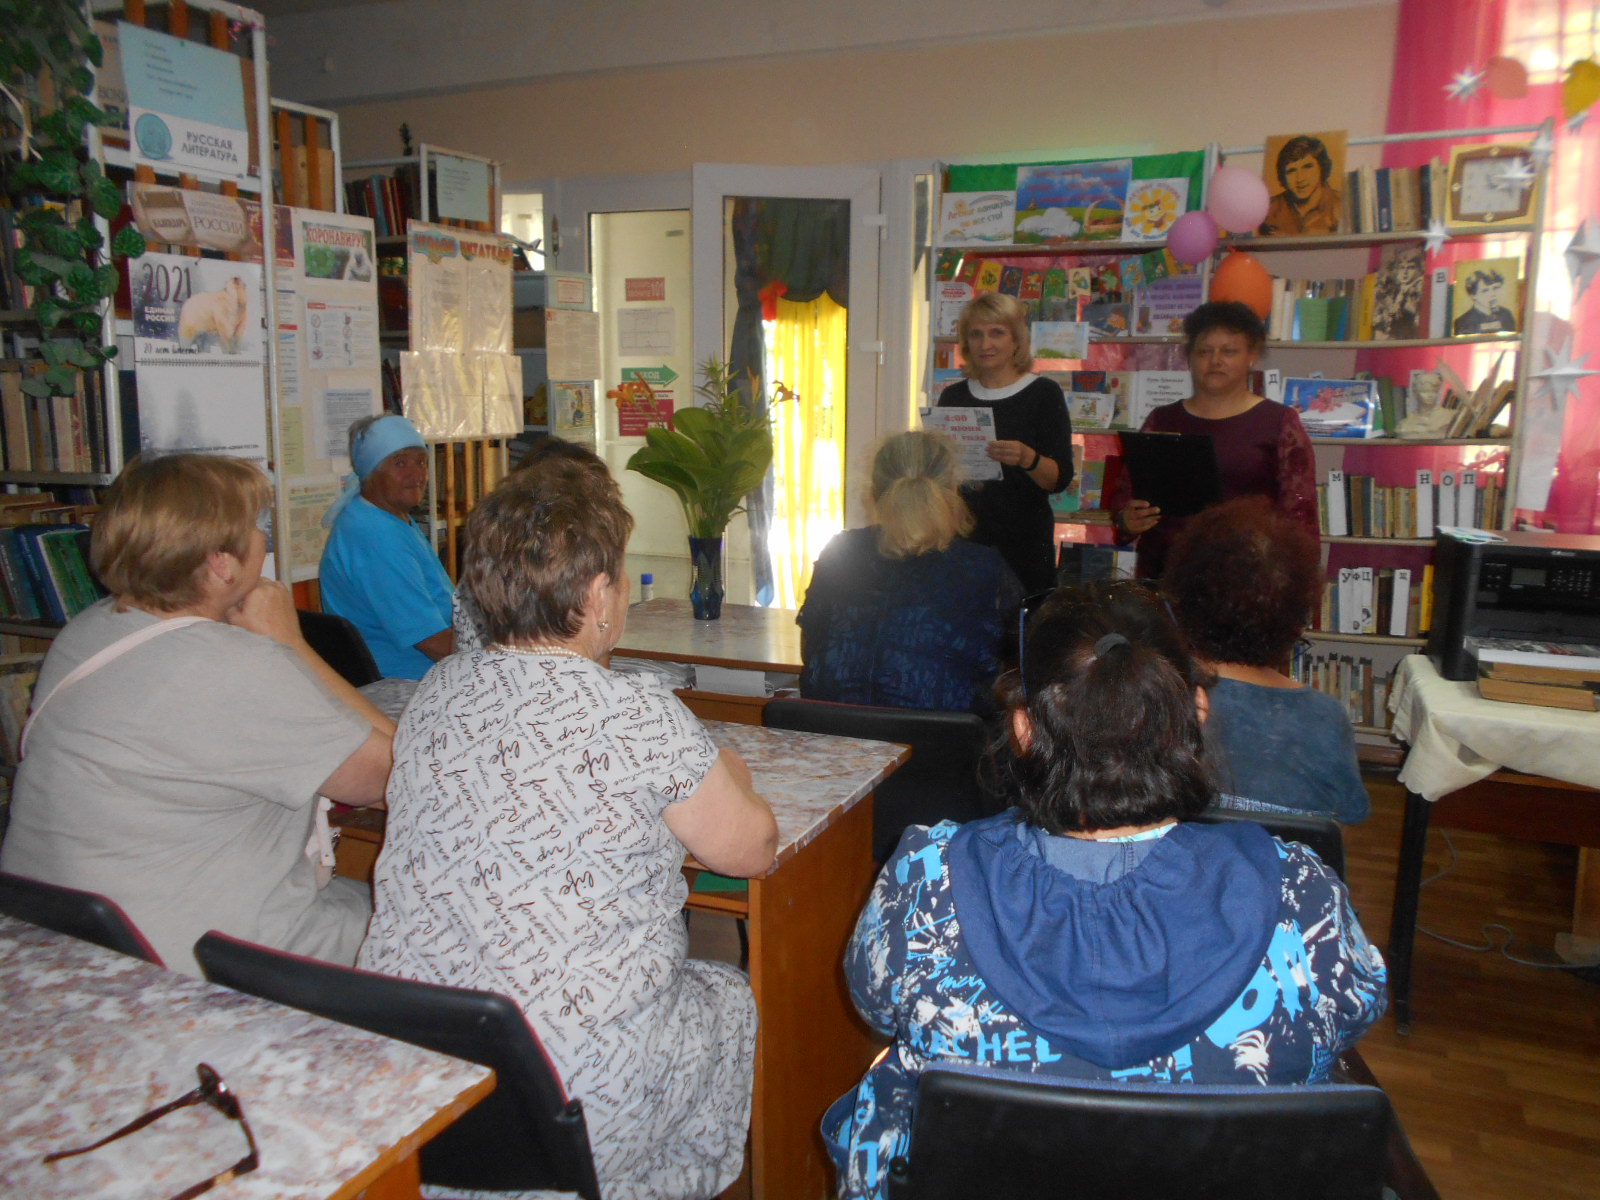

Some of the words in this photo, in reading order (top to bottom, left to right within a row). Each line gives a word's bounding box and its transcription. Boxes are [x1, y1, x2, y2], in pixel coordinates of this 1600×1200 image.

[187, 131, 233, 150] РУССКАЯ
[181, 143, 238, 163] ЛИТЕРАТУРА
[193, 215, 243, 234] РОССИИ
[305, 226, 368, 248] КОРОНАВИРУС
[142, 262, 192, 303] 2021
[1331, 473, 1341, 482] М
[1419, 473, 1430, 484] Н
[1442, 475, 1453, 486] О
[1463, 474, 1475, 485] П
[1342, 572, 1351, 583] У
[1352, 573, 1360, 581] Ф
[1362, 571, 1371, 582] Ц
